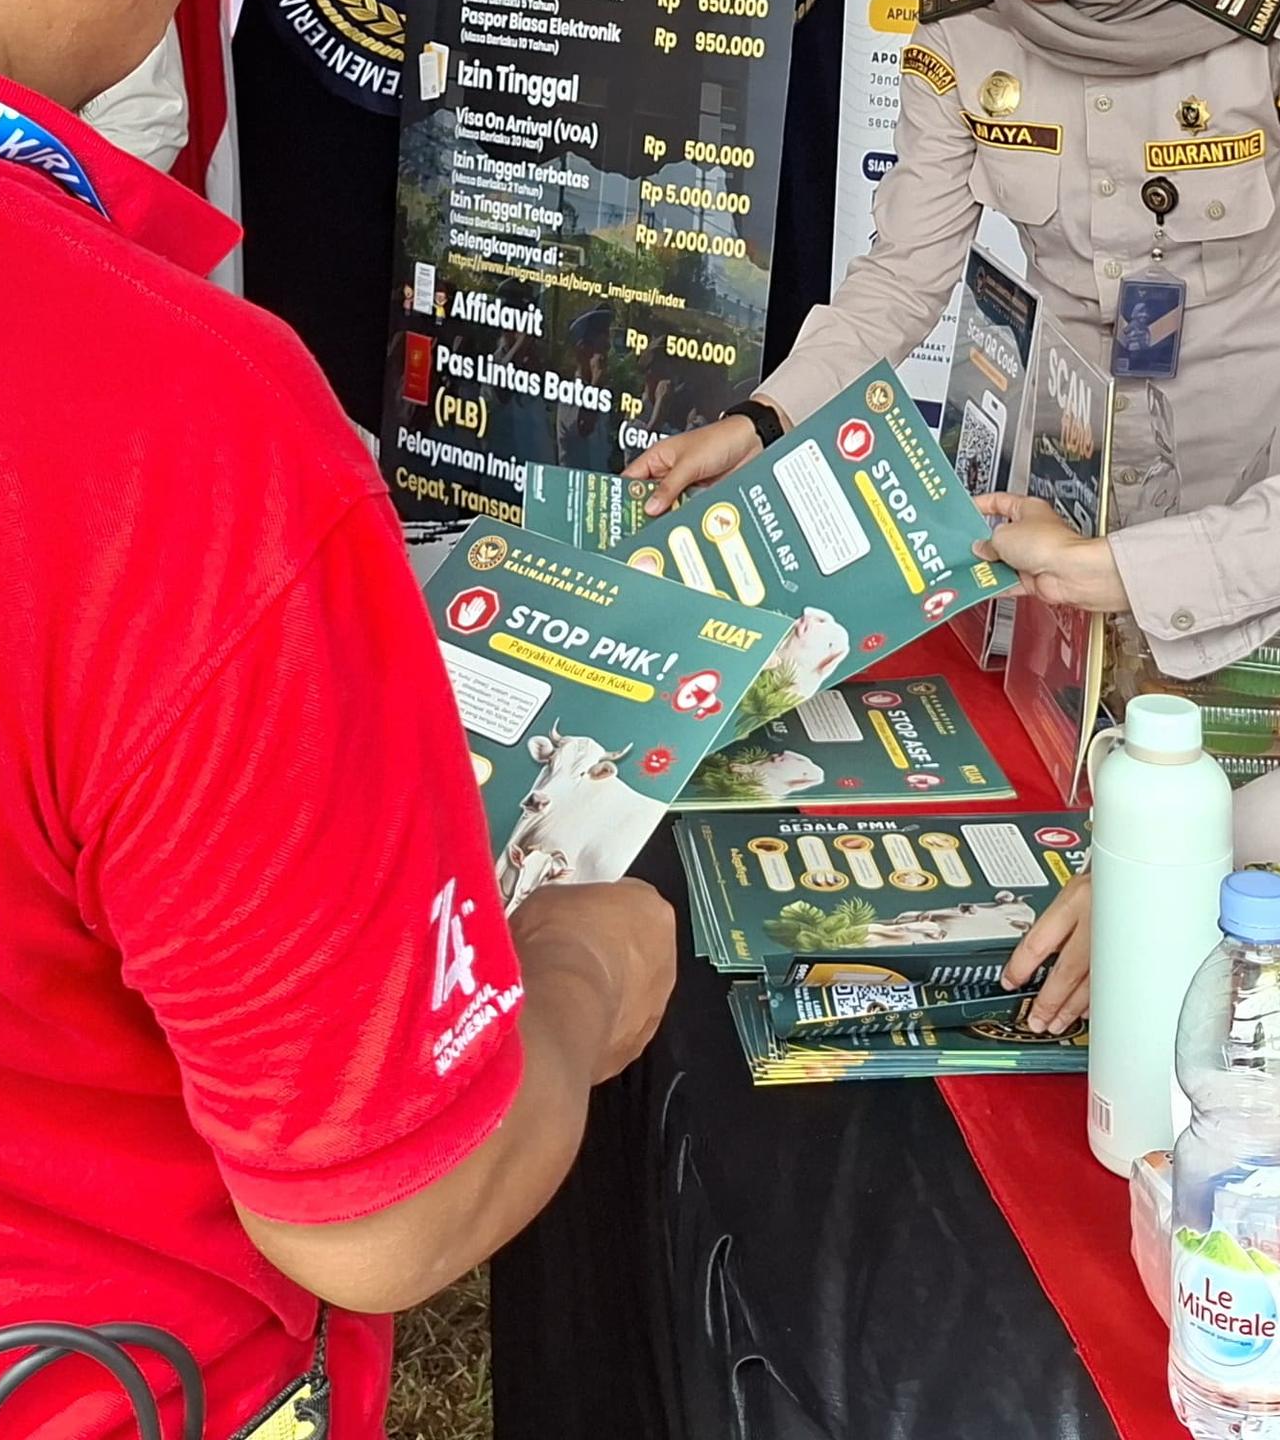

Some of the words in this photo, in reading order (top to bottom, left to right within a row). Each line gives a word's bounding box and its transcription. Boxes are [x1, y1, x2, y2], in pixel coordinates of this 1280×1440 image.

[461, 7, 508, 32] Paspor
[509, 12, 548, 34] Biasa
[549, 17, 622, 43] Elektronik
[654, 27, 677, 54] Rp
[695, 29, 765, 58] 950.000
[457, 60, 492, 90] Izin
[496, 64, 580, 108] Tinggal
[456, 106, 483, 127] Visa
[484, 111, 504, 131] On
[506, 114, 552, 139] Arrival
[553, 117, 599, 150] (VOA)
[644, 134, 666, 162] Rp
[683, 140, 755, 168] 500.000
[975, 122, 1034, 145] MAYA
[1150, 138, 1260, 168] QUARANTINE
[453, 150, 474, 170] Izin
[476, 153, 526, 182] Tinggal
[527, 162, 590, 189] Terbatas
[640, 179, 663, 207] Rp
[664, 185, 751, 215] 5.000.000
[450, 190, 471, 210] Izin
[473, 194, 523, 222] Tinggal
[523, 203, 564, 231] Tetap
[635, 223, 658, 251] Rp
[662, 231, 747, 259] 7.000.000
[450, 290, 545, 338] Affidavit
[625, 328, 649, 356] Rp
[665, 335, 737, 368] 500.000
[436, 344, 475, 379] Pas
[477, 355, 542, 397] Lintas
[543, 371, 614, 414] Batas
[620, 391, 644, 419] Rp
[1047, 346, 1093, 422] SCAN
[434, 386, 489, 440] (PLB)
[397, 426, 485, 475] Pelayanan
[395, 467, 449, 505] Cepat,
[748, 483, 781, 546] GEJALA
[775, 543, 800, 573] ASF
[872, 459, 918, 524] STOP
[907, 529, 952, 587] ASF!
[510, 548, 620, 596] KARANTINA
[505, 604, 590, 651] STOP
[590, 636, 662, 678] PMK
[700, 617, 762, 651] KUAT
[509, 639, 556, 668] Penyakit
[555, 653, 586, 678] Mulut
[586, 668, 607, 684] dan
[606, 672, 634, 694] Kuku
[1177, 1281, 1278, 1338] Minerale
[1204, 1276, 1234, 1311] Le
